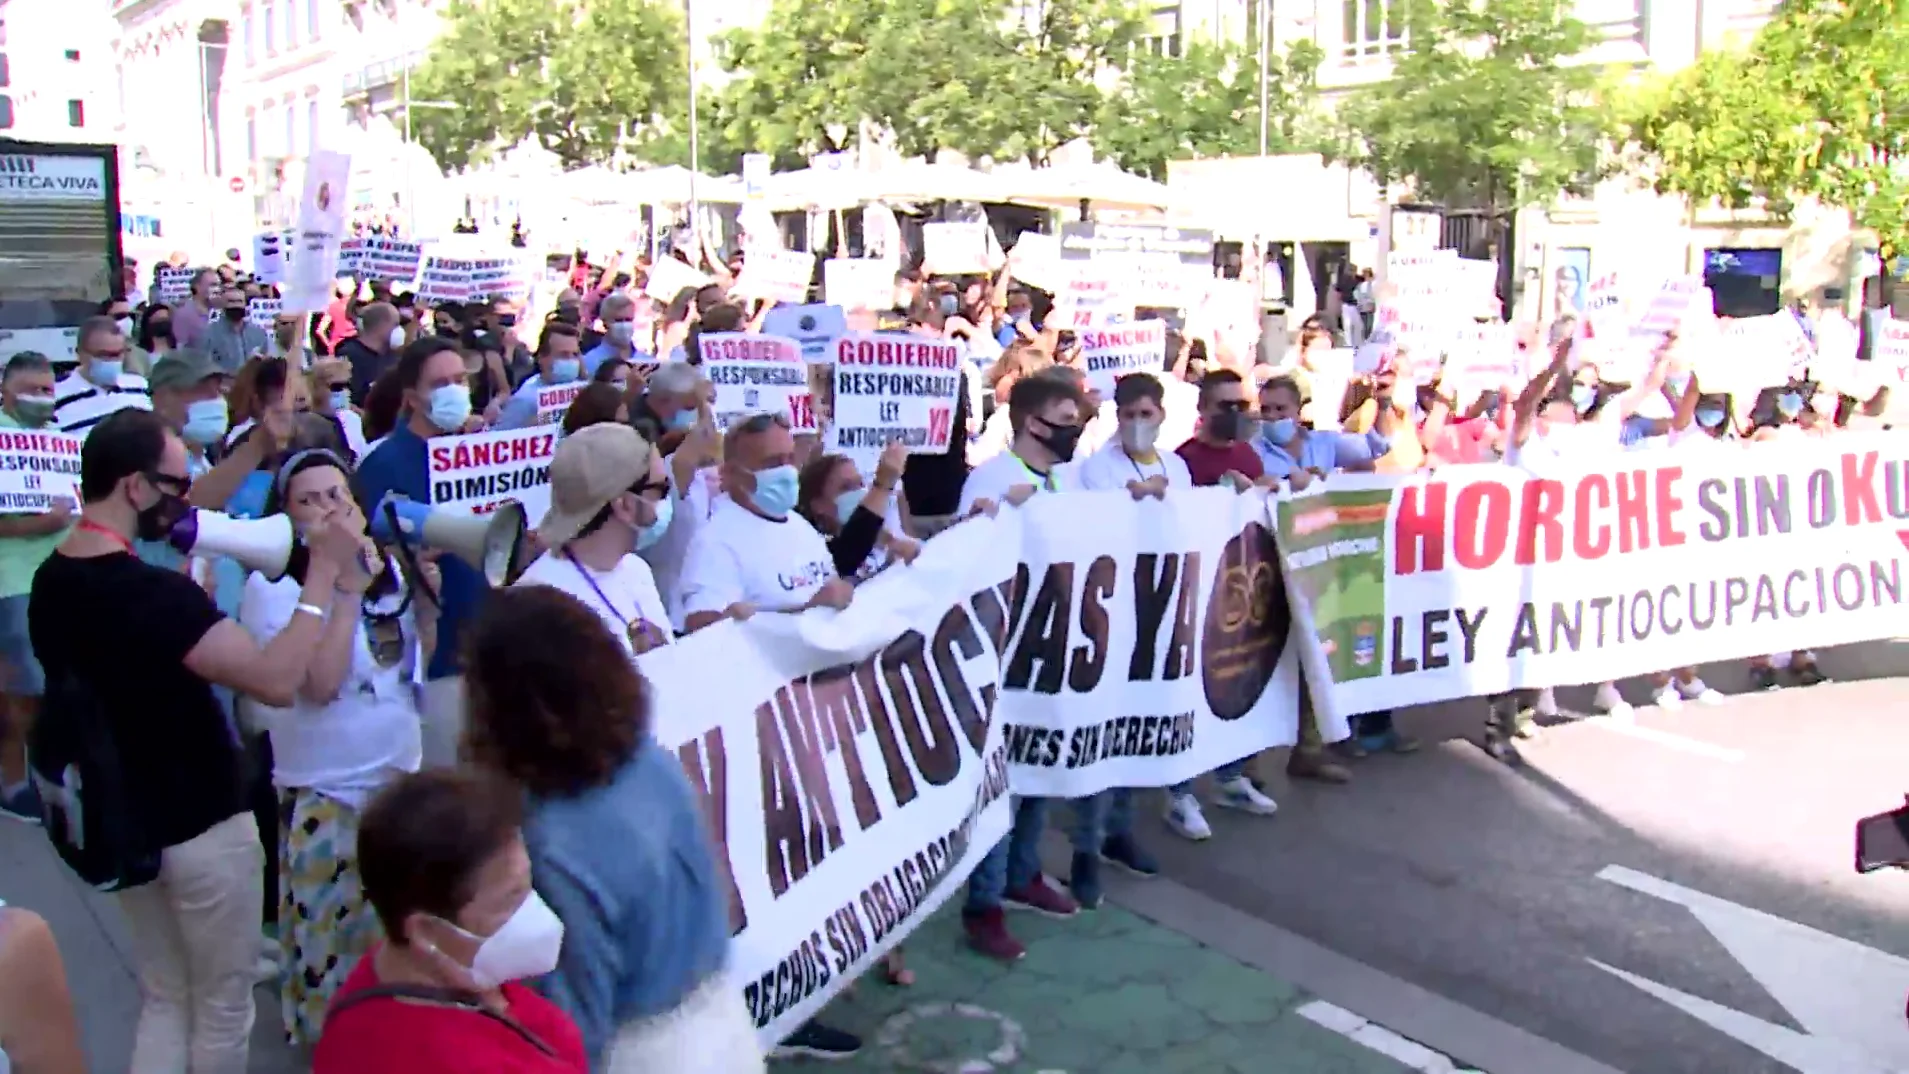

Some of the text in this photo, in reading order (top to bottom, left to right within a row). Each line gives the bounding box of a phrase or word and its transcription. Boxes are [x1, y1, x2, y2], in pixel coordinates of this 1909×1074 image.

[57, 176, 98, 189] VIVA
[838, 340, 958, 370] GOBIERNO
[840, 371, 957, 398] RESPONSABLE
[788, 393, 816, 428] YA
[880, 401, 900, 423] LEY
[432, 433, 554, 473] SÁNCHEZ
[434, 463, 552, 505] DIMISIÓN
[1395, 466, 1687, 577] HORCHE
[1698, 473, 1793, 543] SIN
[1128, 551, 1201, 683] YA
[1391, 606, 1489, 676] LEY
[825, 901, 868, 975] SIN
[1065, 722, 1102, 770] SIN
[1101, 709, 1195, 762] DERECHOS
